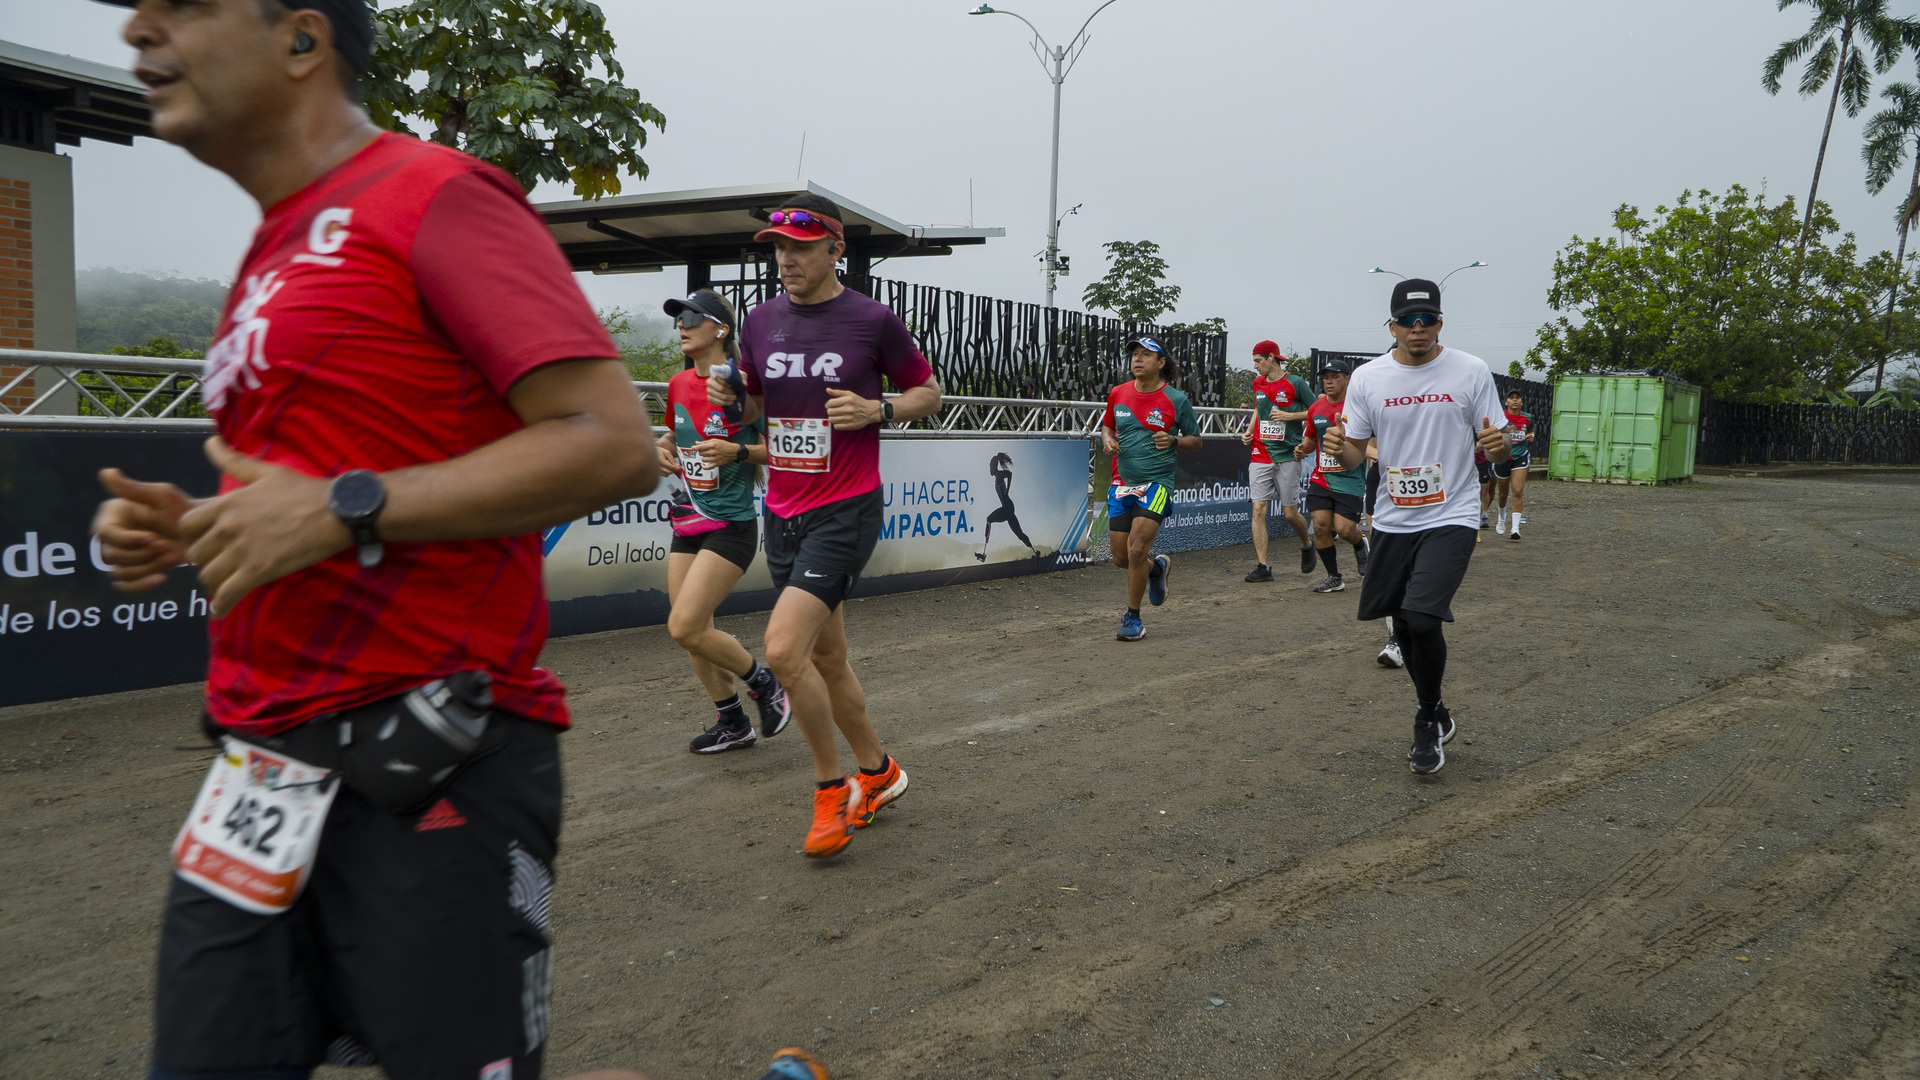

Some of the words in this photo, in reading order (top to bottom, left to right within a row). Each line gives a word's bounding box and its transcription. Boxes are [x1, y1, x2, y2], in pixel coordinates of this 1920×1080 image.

[308, 207, 353, 254] G
[1384, 393, 1454, 407] HONDA
[1263, 426, 1281, 434] 2129
[773, 435, 816, 454] 1625
[881, 483, 893, 507] U
[903, 480, 974, 506] HACER,
[1173, 488, 1197, 504] anco
[1199, 483, 1211, 502] de
[1213, 482, 1250, 501] Occiden
[1399, 479, 1428, 494] 339
[879, 510, 974, 541] MPACTA.
[1164, 514, 1177, 528] Del
[1178, 513, 1193, 527] lado
[1194, 512, 1203, 525] de
[1204, 512, 1214, 524] los
[1215, 514, 1227, 526] que
[2, 532, 76, 578] de
[588, 543, 619, 566] Del
[625, 541, 666, 564] lado
[1056, 553, 1084, 565] AVAL
[47, 600, 101, 630] los
[113, 600, 178, 631] que
